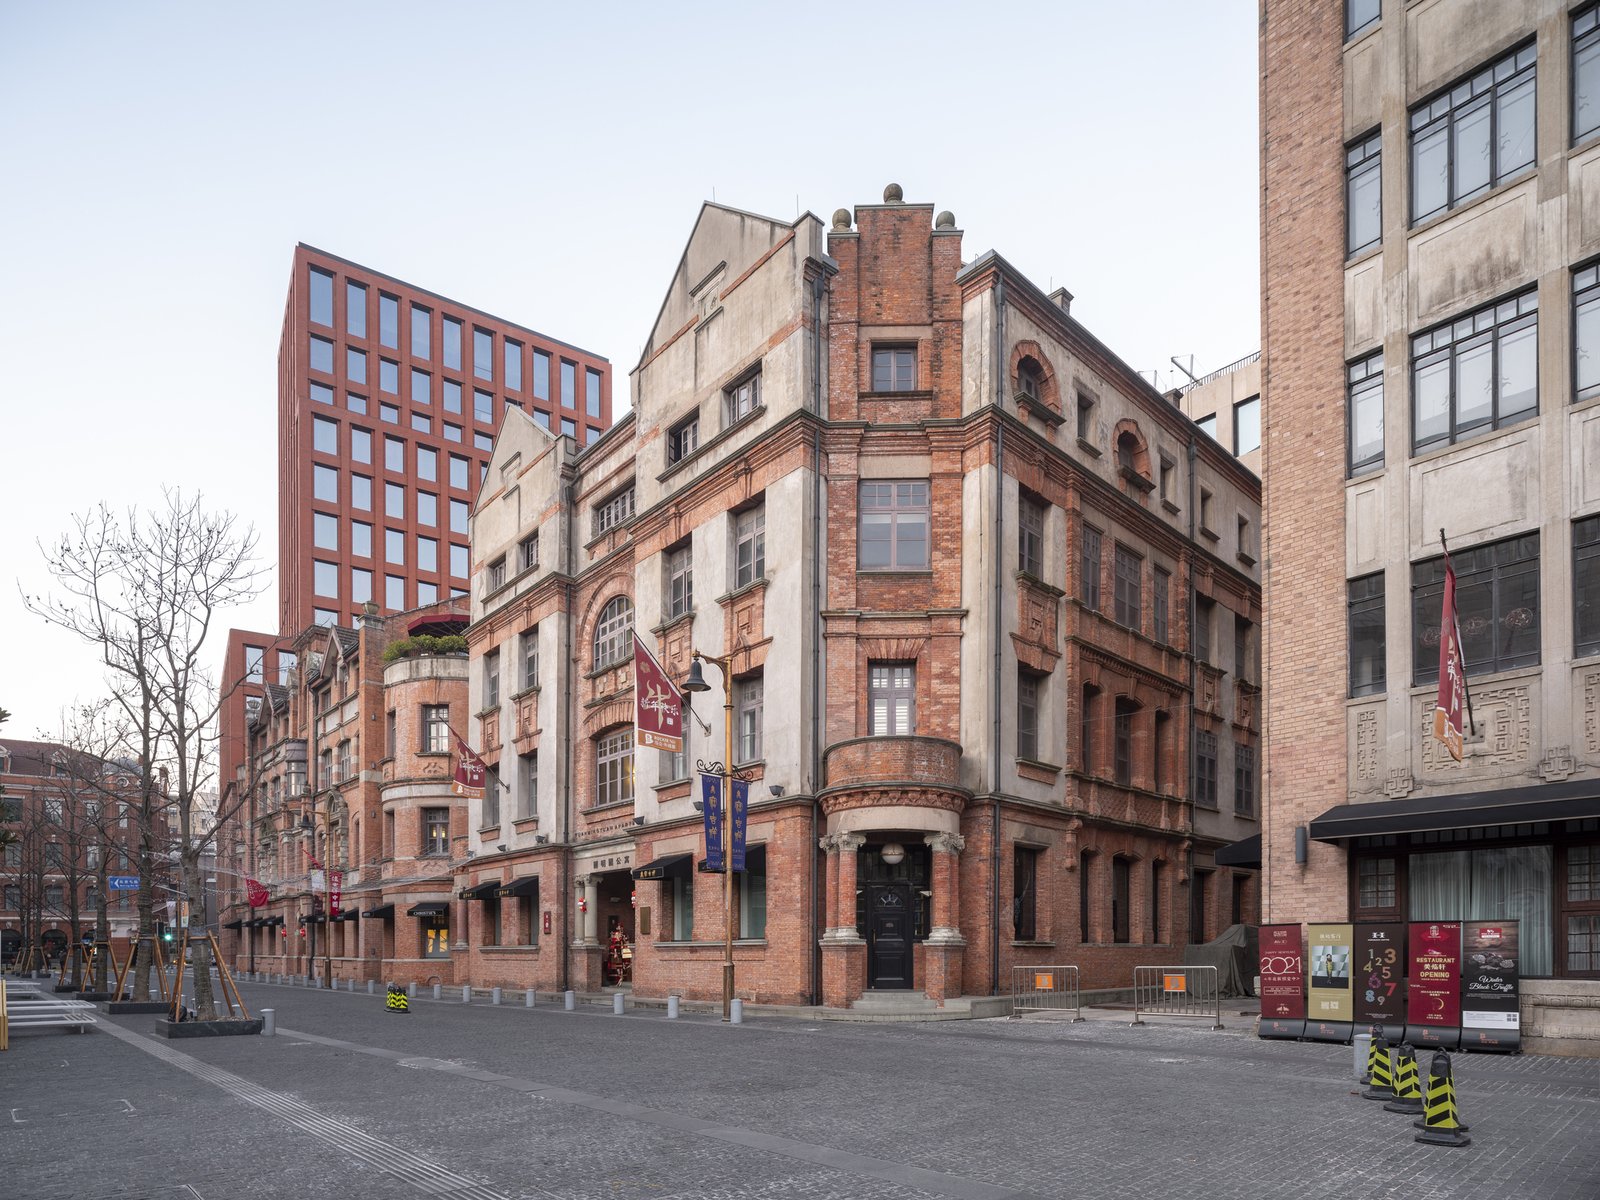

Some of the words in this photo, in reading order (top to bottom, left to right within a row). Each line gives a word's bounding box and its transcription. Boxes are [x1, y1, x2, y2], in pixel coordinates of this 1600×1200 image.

[1368, 949, 1374, 959] 1
[1384, 948, 1397, 964] 3
[1261, 956, 1301, 975] 2021
[1363, 960, 1373, 973] 4
[1375, 957, 1382, 966] 2
[1382, 966, 1391, 979] 5
[1420, 971, 1450, 979] OPENING
[1478, 975, 1503, 983] Winter
[1368, 972, 1381, 989] 6
[1385, 982, 1397, 997] 7
[1491, 983, 1514, 992] Truffle
[1365, 989, 1375, 1003] 8
[1377, 996, 1385, 1006] 9
